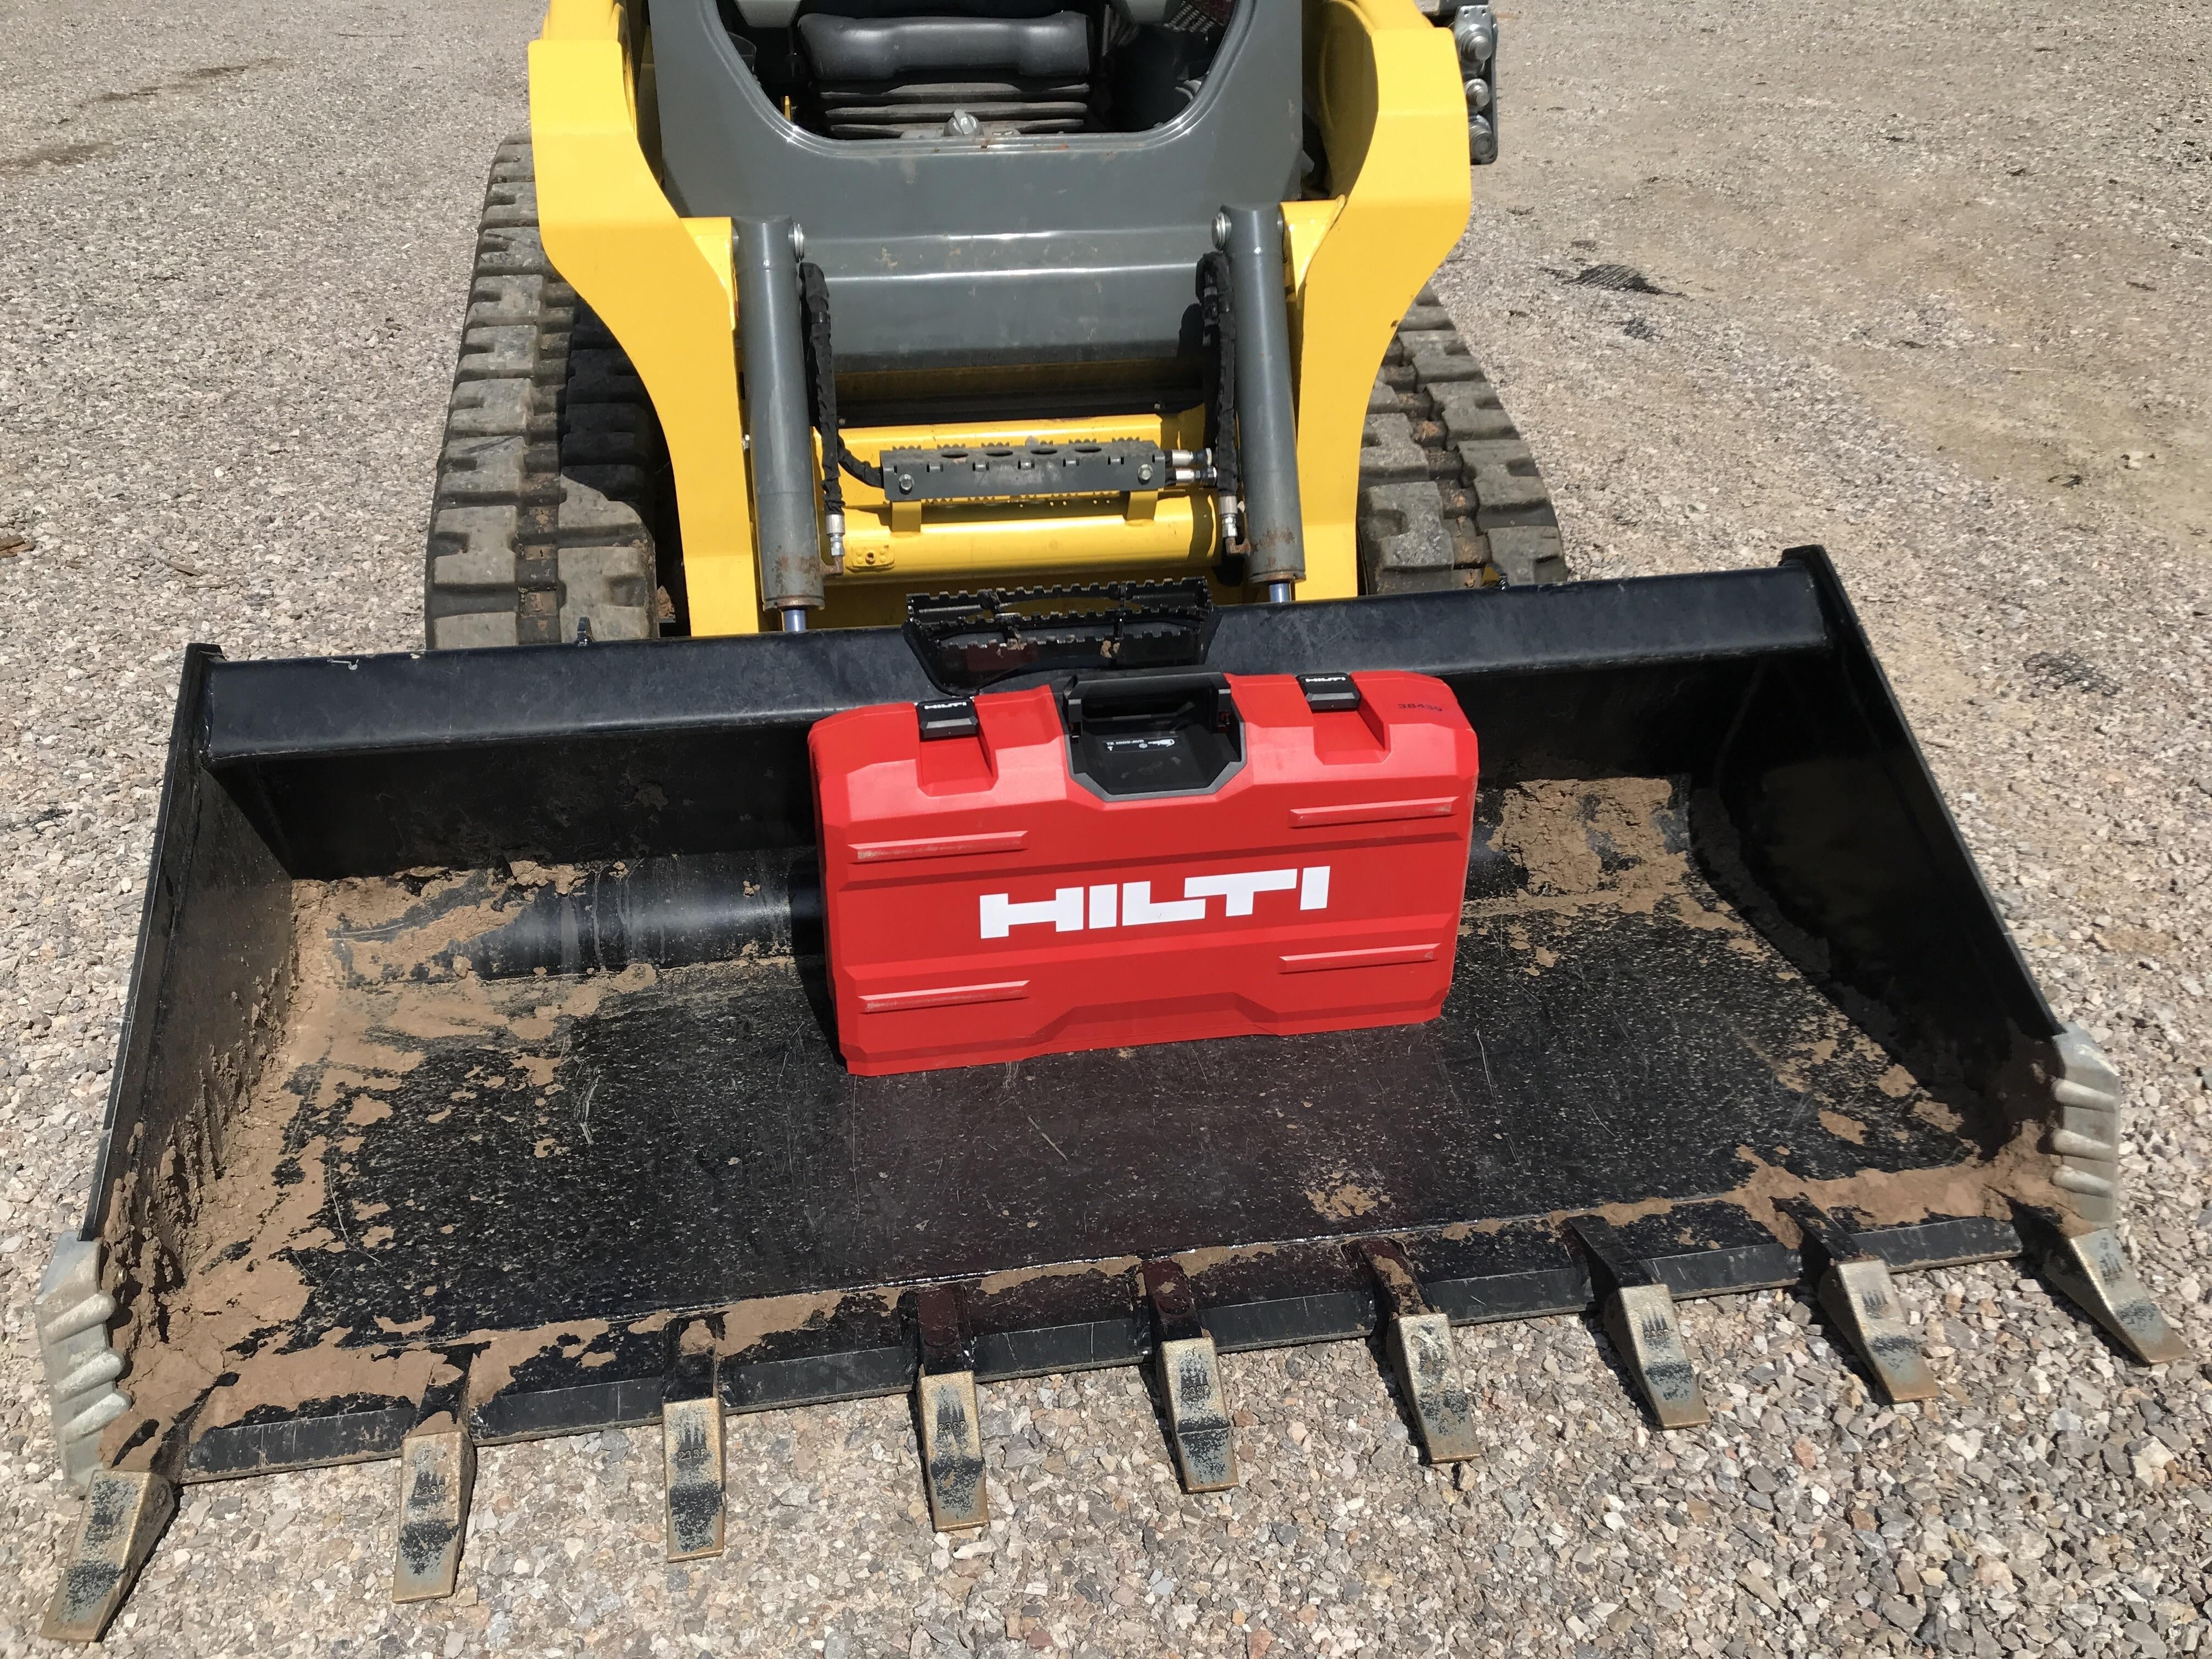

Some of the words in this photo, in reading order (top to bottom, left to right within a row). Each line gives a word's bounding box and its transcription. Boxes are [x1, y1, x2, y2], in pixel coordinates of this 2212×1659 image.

[924, 702, 967, 710] HILTI
[980, 866, 1330, 939] HILTI
[938, 1421, 966, 1434] 23SP
[678, 1448, 707, 1462] 23SP
[414, 1484, 445, 1498] 23SP
